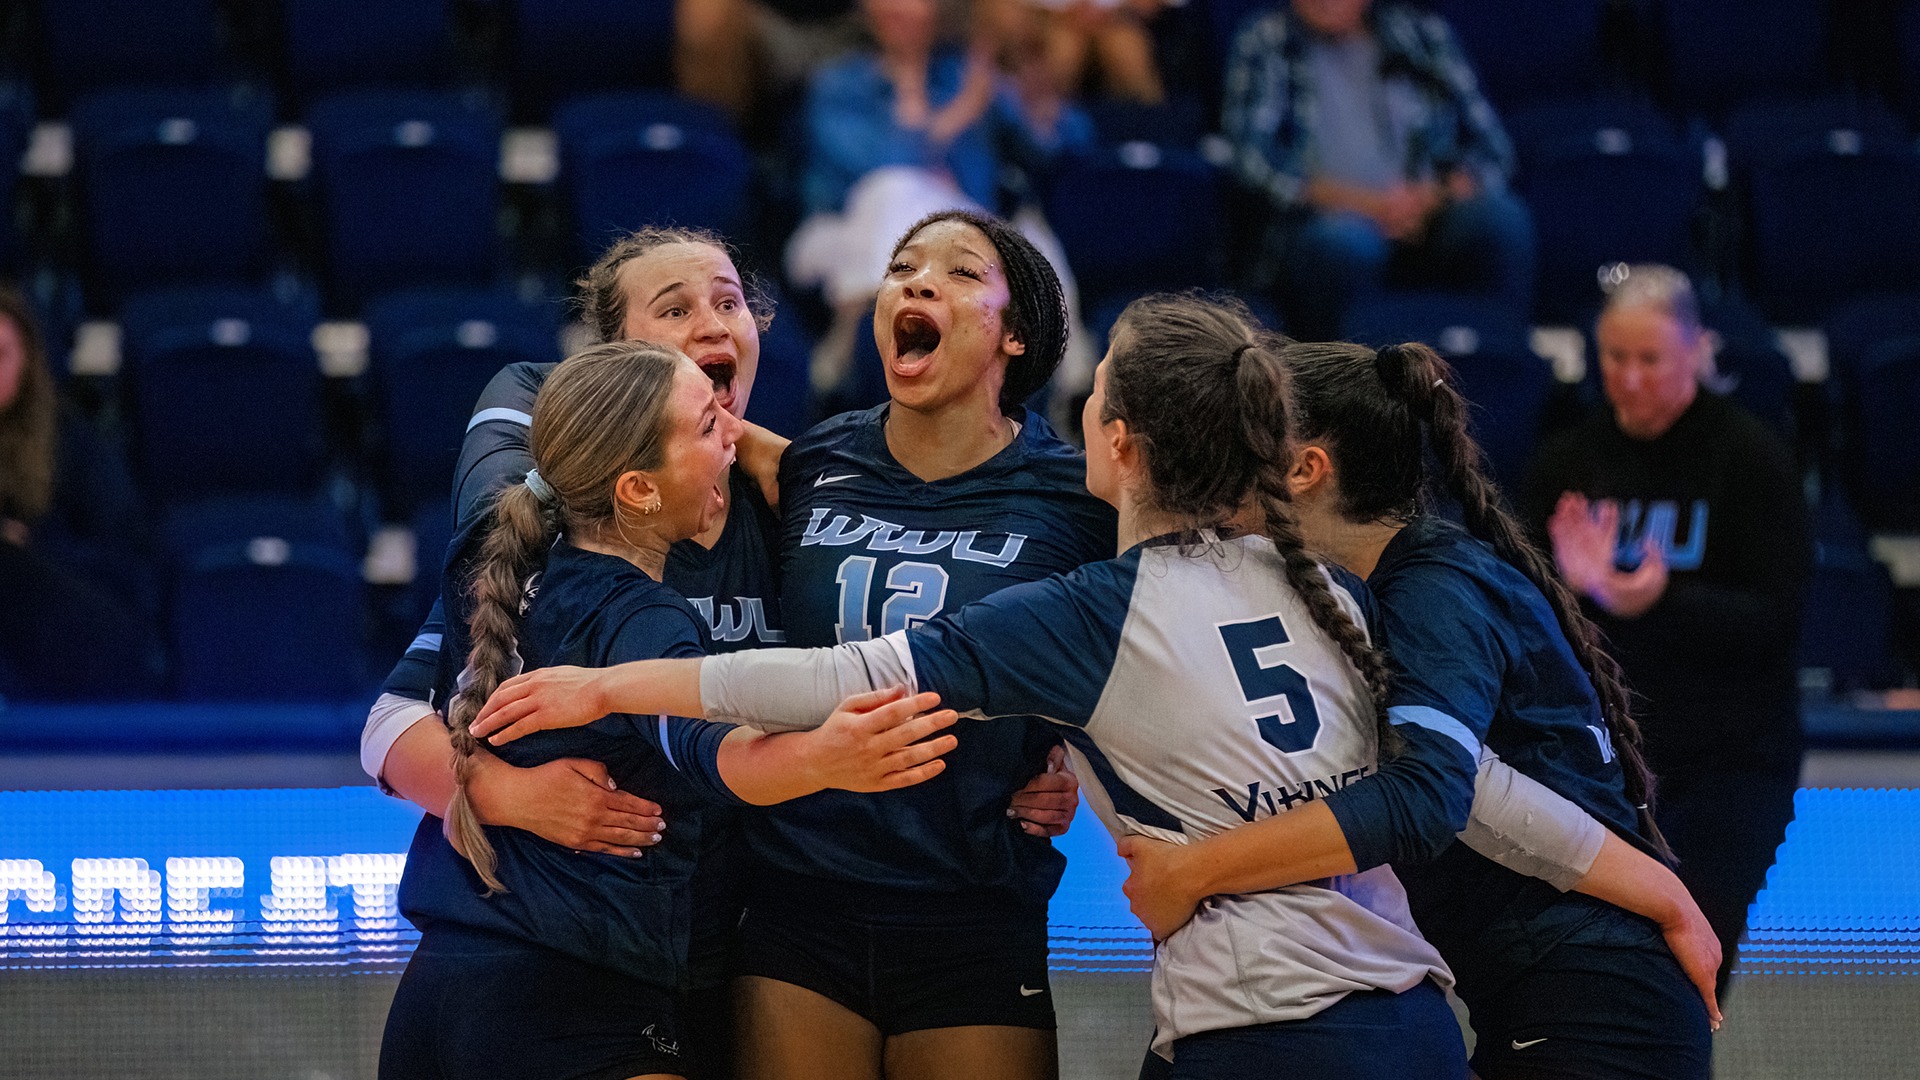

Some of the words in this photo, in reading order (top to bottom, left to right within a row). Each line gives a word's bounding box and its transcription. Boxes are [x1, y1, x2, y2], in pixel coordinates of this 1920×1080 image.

[800, 507, 1028, 568] WWU
[1588, 499, 1709, 569] WU
[834, 555, 949, 645] 12
[1215, 611, 1324, 758] 5
